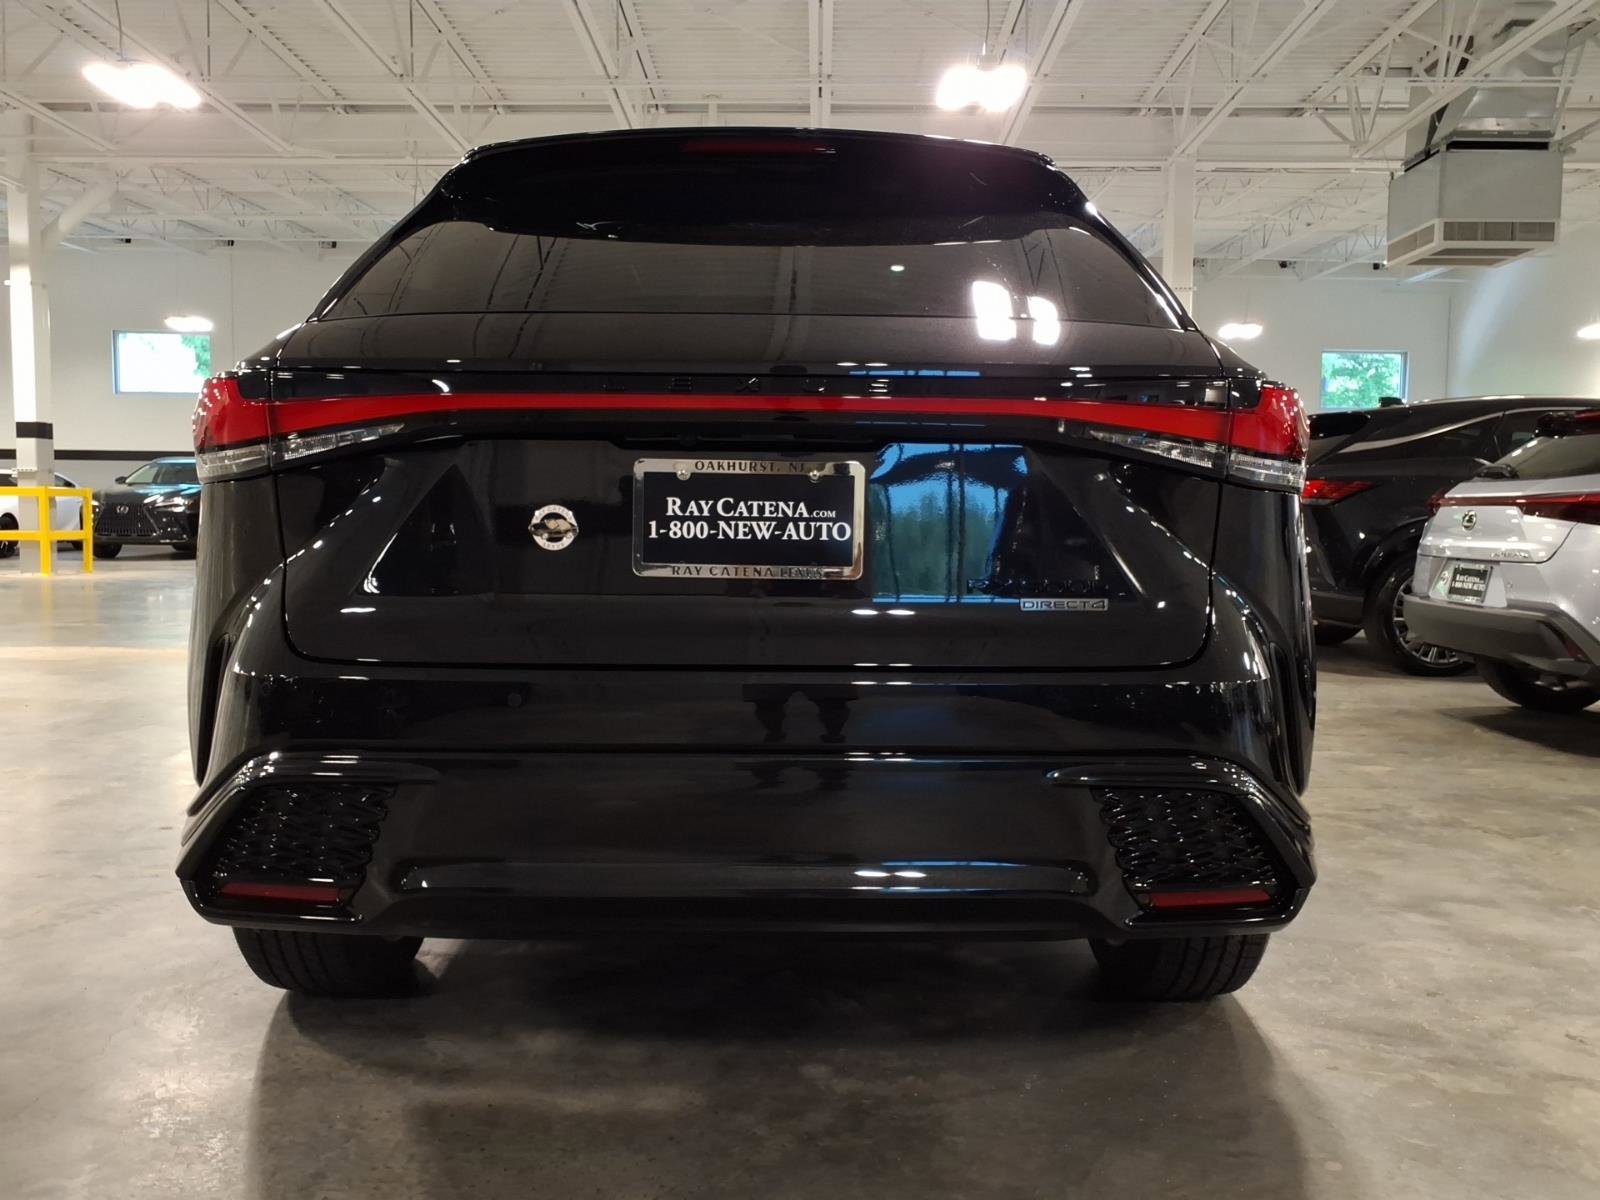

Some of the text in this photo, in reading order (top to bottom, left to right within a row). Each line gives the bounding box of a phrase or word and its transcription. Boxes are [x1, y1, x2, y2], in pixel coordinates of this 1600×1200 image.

[788, 461, 804, 473] NJ
[647, 520, 852, 542] 1-800-NEW-AUTO
[671, 564, 703, 576] RAY
[708, 565, 774, 578] CATENA
[1021, 599, 1107, 610] DIRECT4
